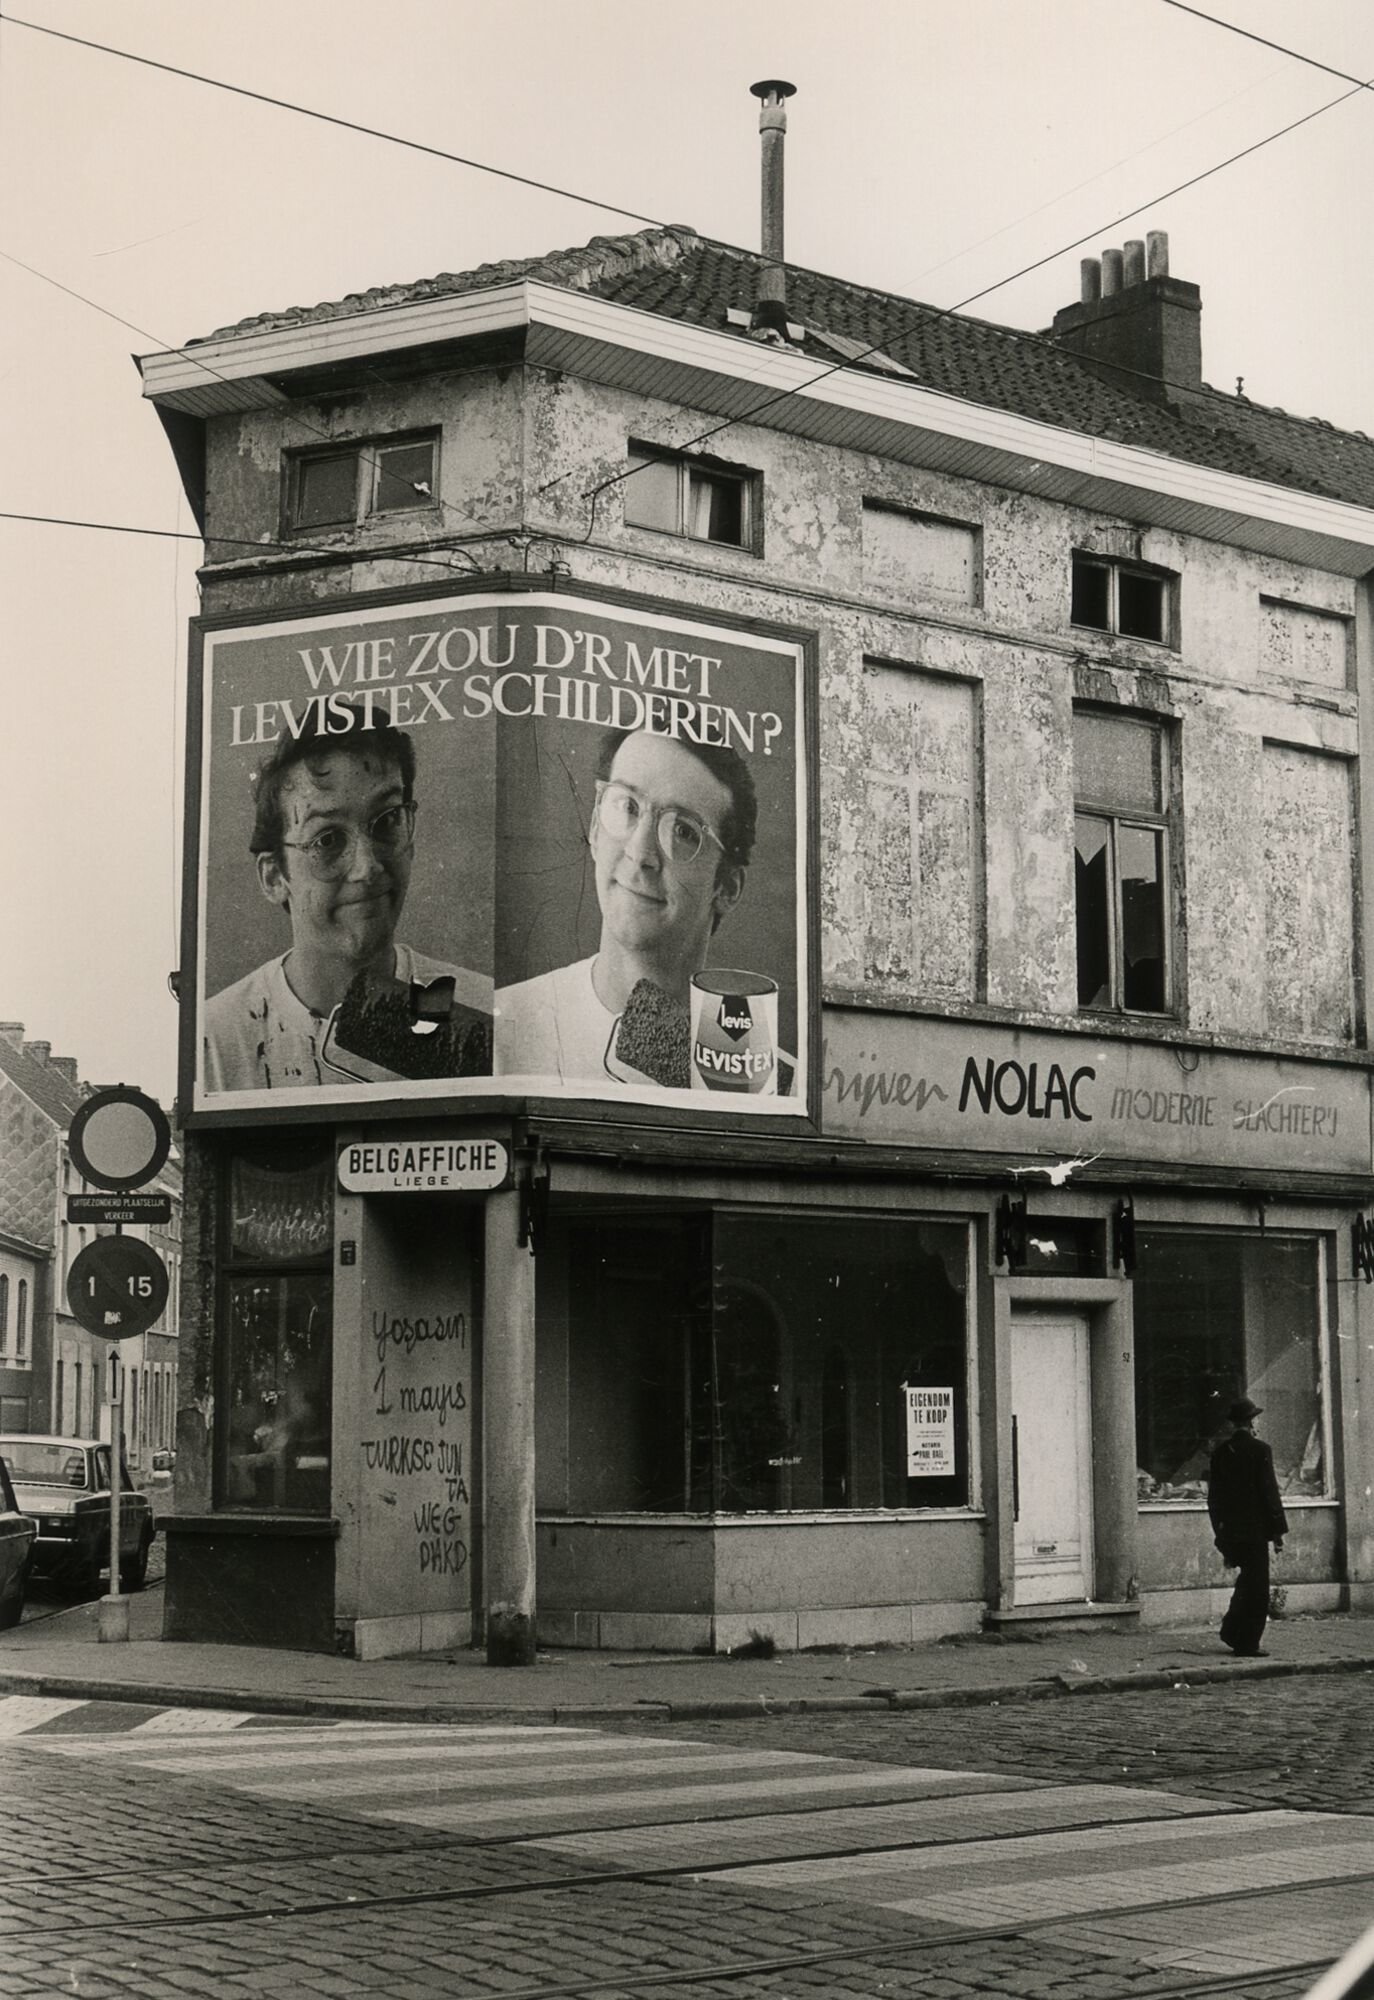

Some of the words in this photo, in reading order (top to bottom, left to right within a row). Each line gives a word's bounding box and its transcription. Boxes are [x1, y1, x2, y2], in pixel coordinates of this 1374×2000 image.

[298, 637, 396, 689] WIE
[405, 624, 520, 677] ZOU
[533, 625, 618, 681] D'R
[620, 641, 722, 698] MET
[229, 678, 455, 746] LEVISTEX
[462, 674, 783, 756] SCHILDEREN?
[721, 1004, 752, 1029] levis
[958, 1056, 1096, 1122] NOLAC
[1110, 1087, 1218, 1127] MODERNE
[349, 1145, 497, 1174] BELGAFFICHE
[394, 1176, 450, 1187] LIEGE
[72, 1198, 122, 1207] UITGEZONDERD
[123, 1198, 166, 1207] PLAATSELIJK
[104, 1212, 135, 1220] VERKEER
[88, 1276, 96, 1297] 1
[127, 1276, 152, 1297] 15
[374, 1366, 393, 1415] 1
[910, 1393, 950, 1407] EIGENDOM
[914, 1410, 923, 1423] TE
[926, 1409, 947, 1423] KOOP
[445, 1478, 469, 1503] TA
[414, 1502, 462, 1535] WEG
